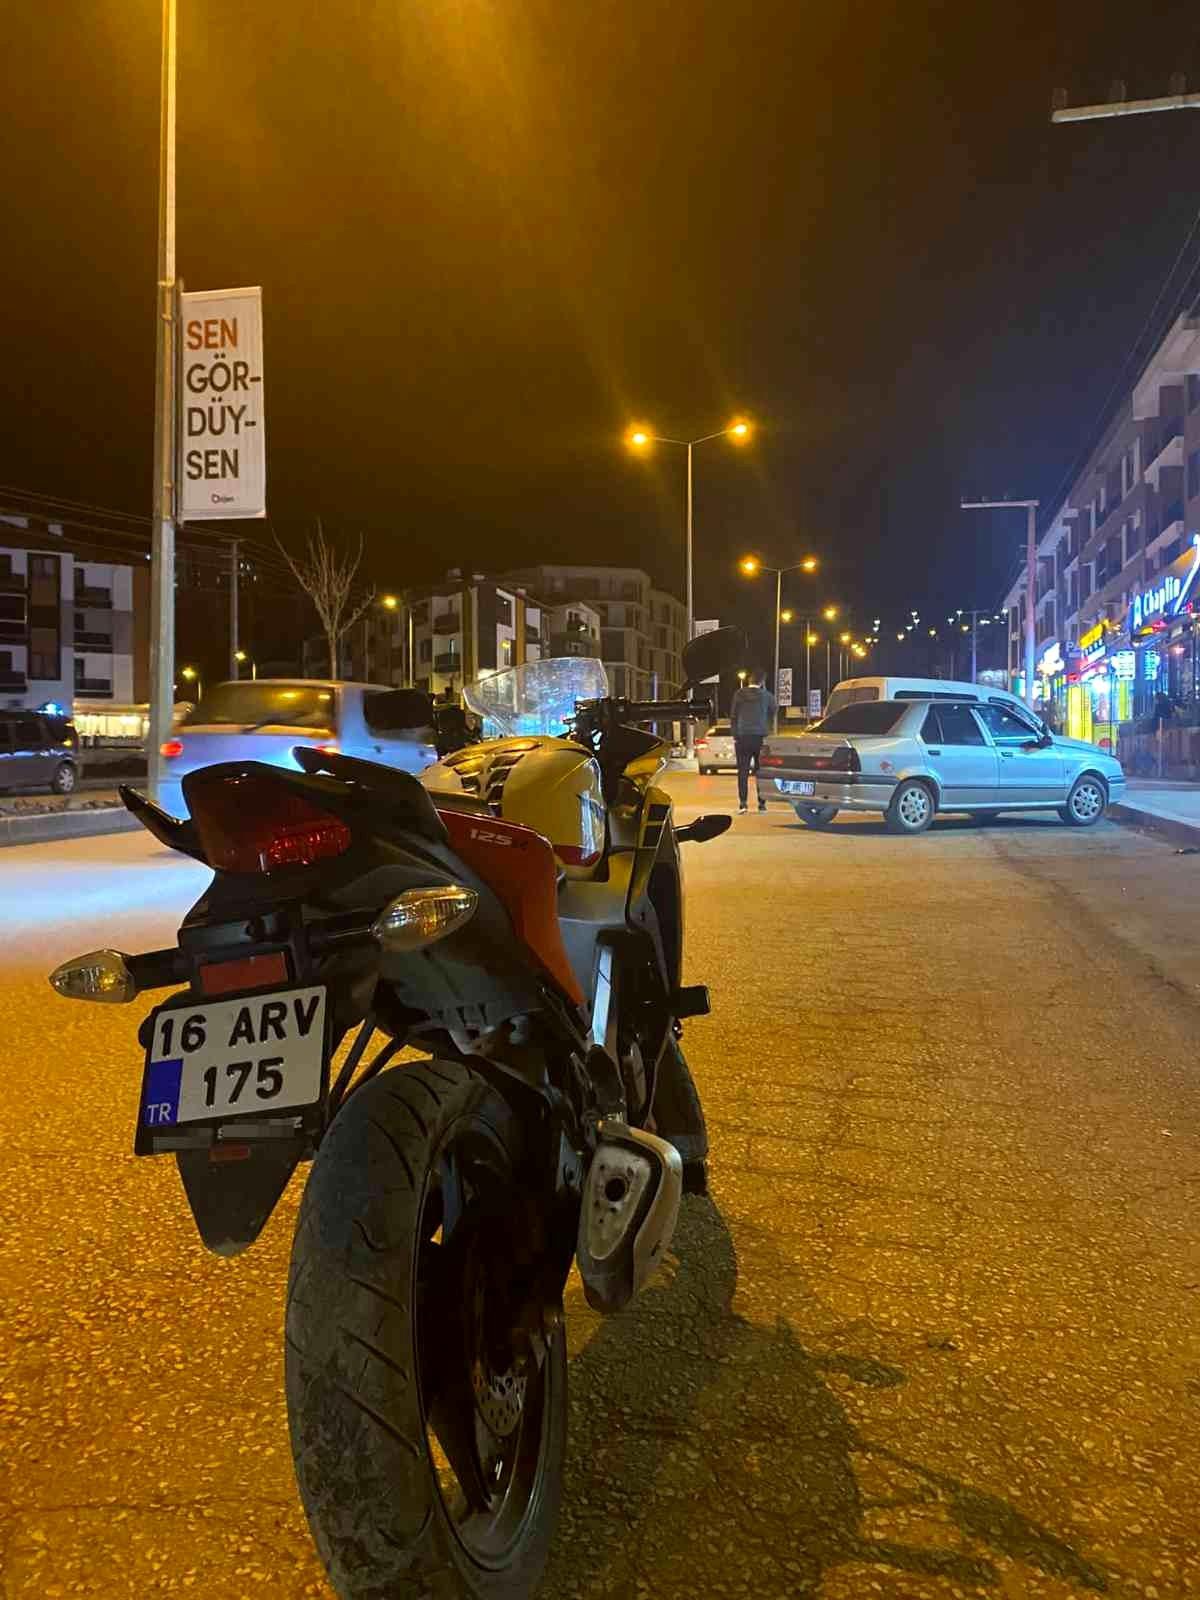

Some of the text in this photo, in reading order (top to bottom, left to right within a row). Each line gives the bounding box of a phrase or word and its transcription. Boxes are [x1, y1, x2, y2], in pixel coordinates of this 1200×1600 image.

[186, 318, 239, 351] SEN
[186, 353, 262, 393] GÖR-
[187, 397, 257, 436] DÜY-
[186, 449, 239, 480] SEN
[470, 828, 513, 846] 125
[160, 995, 320, 1056] 16 ARV
[204, 1057, 285, 1107] 175
[148, 1103, 172, 1124] TR
